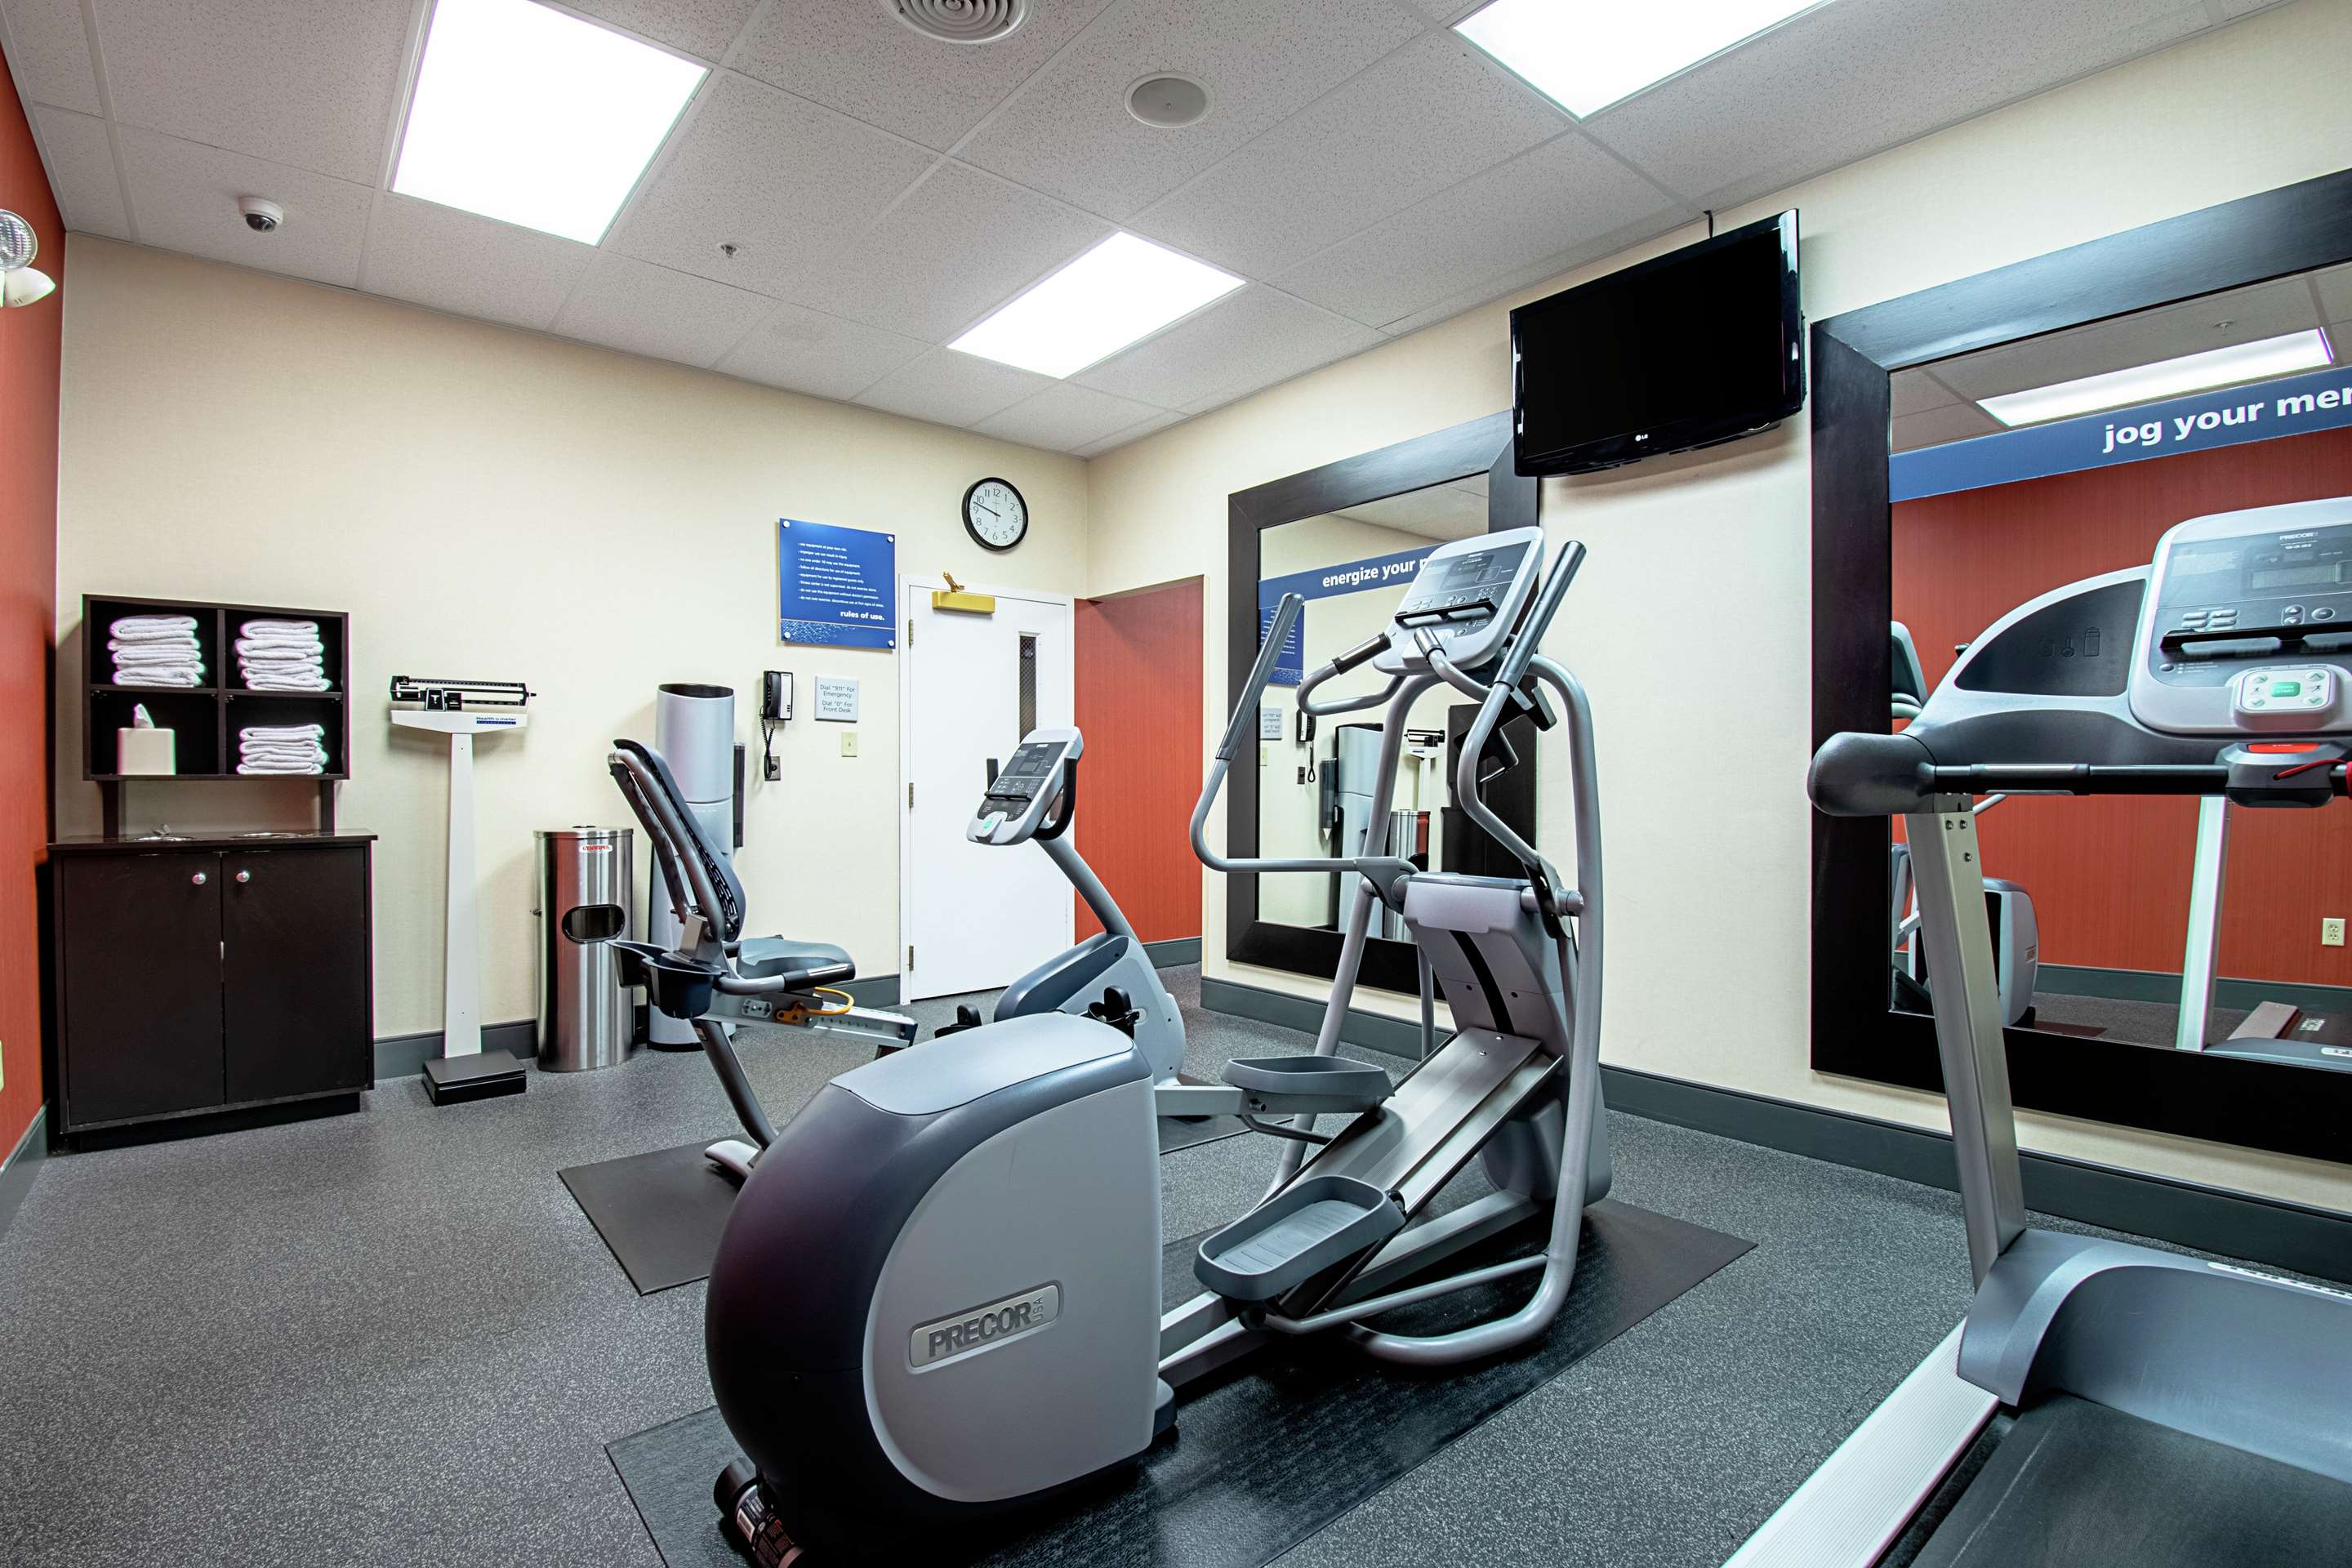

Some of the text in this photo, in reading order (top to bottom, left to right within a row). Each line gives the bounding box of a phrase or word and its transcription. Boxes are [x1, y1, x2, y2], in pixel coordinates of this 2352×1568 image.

[2102, 424, 2162, 453] jog
[2173, 402, 2265, 440] your
[985, 489, 990, 497] 11
[993, 488, 1001, 498] 12
[1004, 493, 1008, 502] 1
[977, 495, 985, 505] 10
[973, 506, 979, 514] 9
[1009, 502, 1015, 511] 2
[976, 517, 982, 526] 8
[1013, 514, 1018, 523] 3
[983, 527, 989, 536] 7
[1009, 525, 1014, 533] 4
[992, 532, 998, 541] 6
[1002, 531, 1008, 539] 5
[1322, 567, 1379, 587] energize
[1382, 559, 1416, 580] your
[840, 610, 858, 618] rules
[860, 611, 869, 619] of
[929, 1295, 1045, 1358] PRECOR USA
